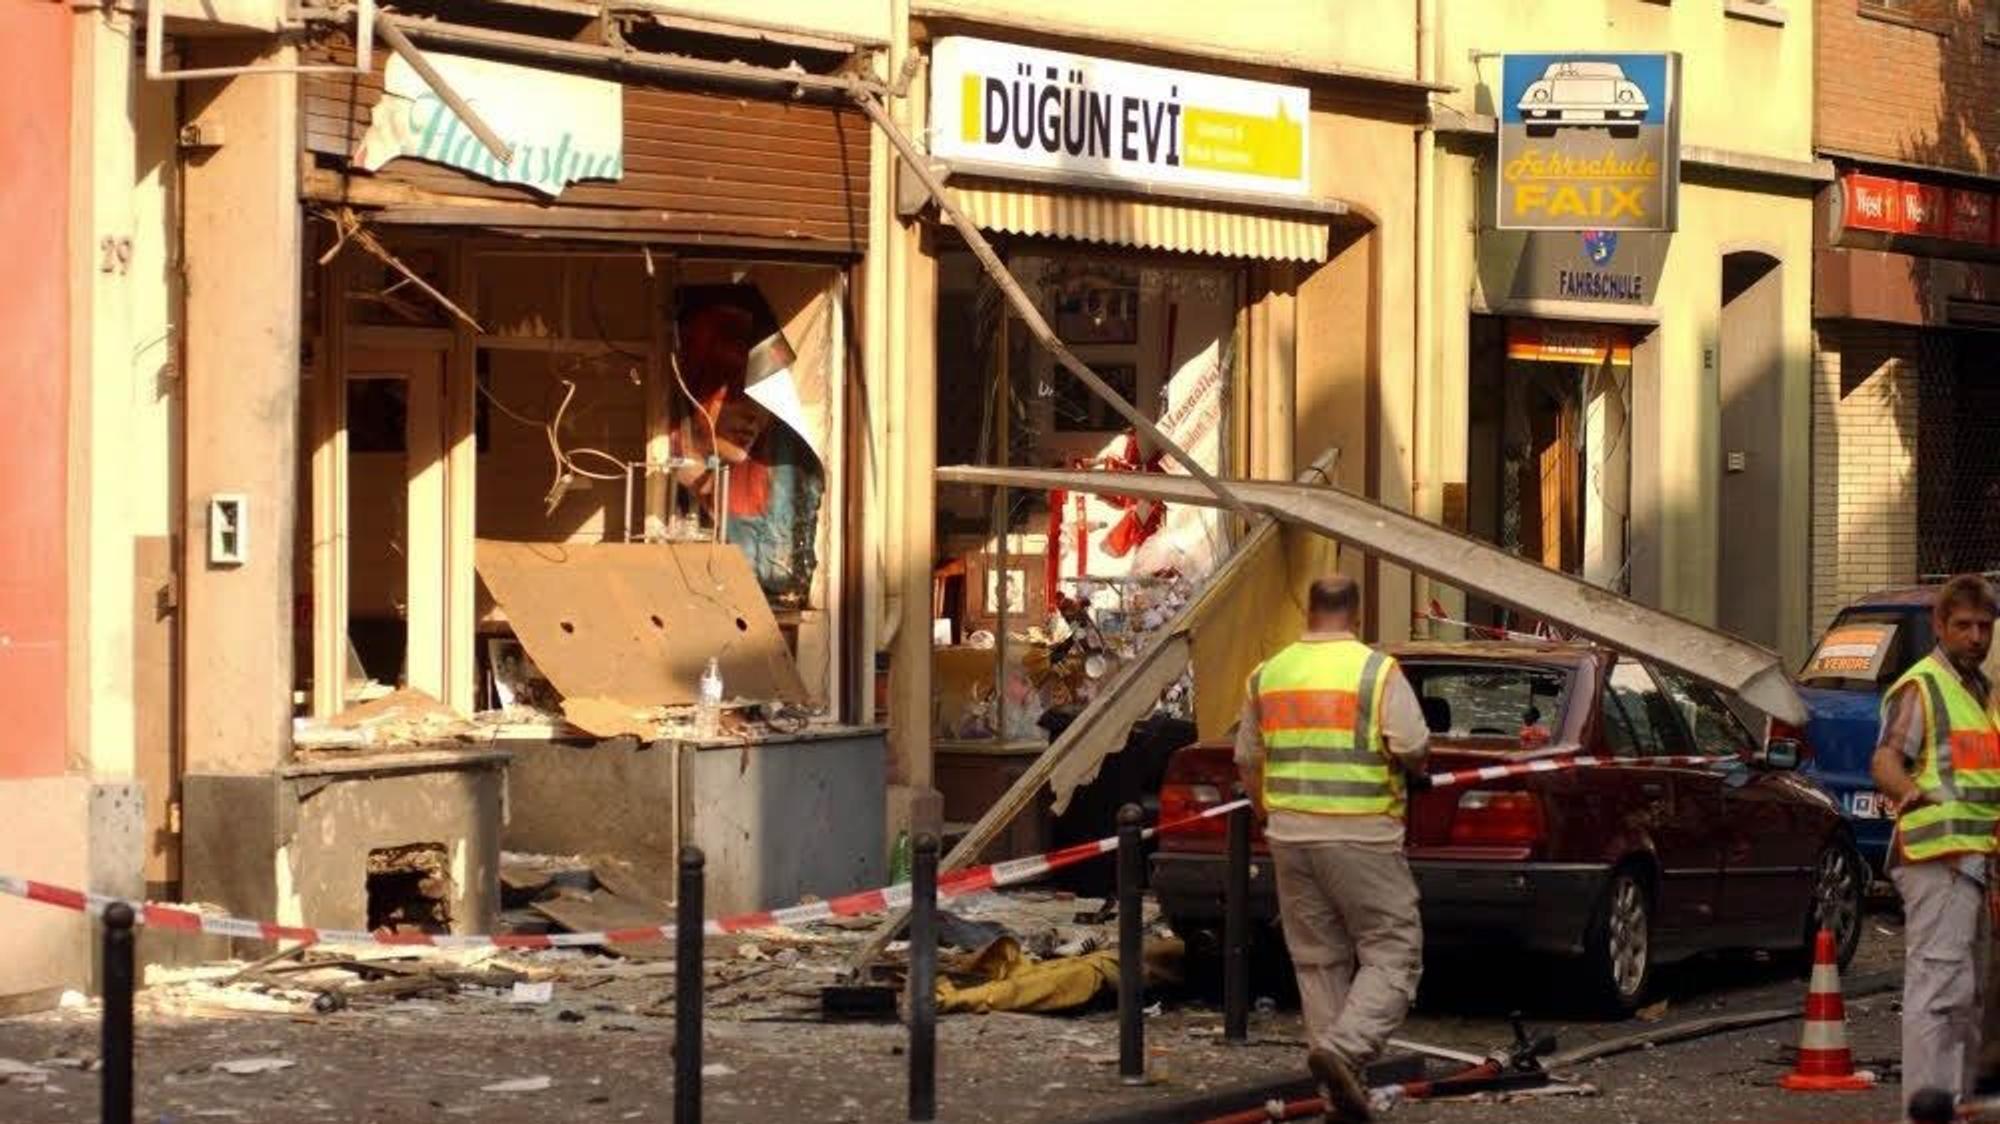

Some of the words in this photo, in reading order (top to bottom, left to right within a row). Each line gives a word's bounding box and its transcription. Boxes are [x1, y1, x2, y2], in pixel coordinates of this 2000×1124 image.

[1504, 146, 1659, 181] Fahrschule
[1514, 184, 1647, 218] FAIX
[1856, 187, 1883, 218] West
[101, 235, 132, 276] 29
[1559, 271, 1642, 299] FAHRSCHULE
